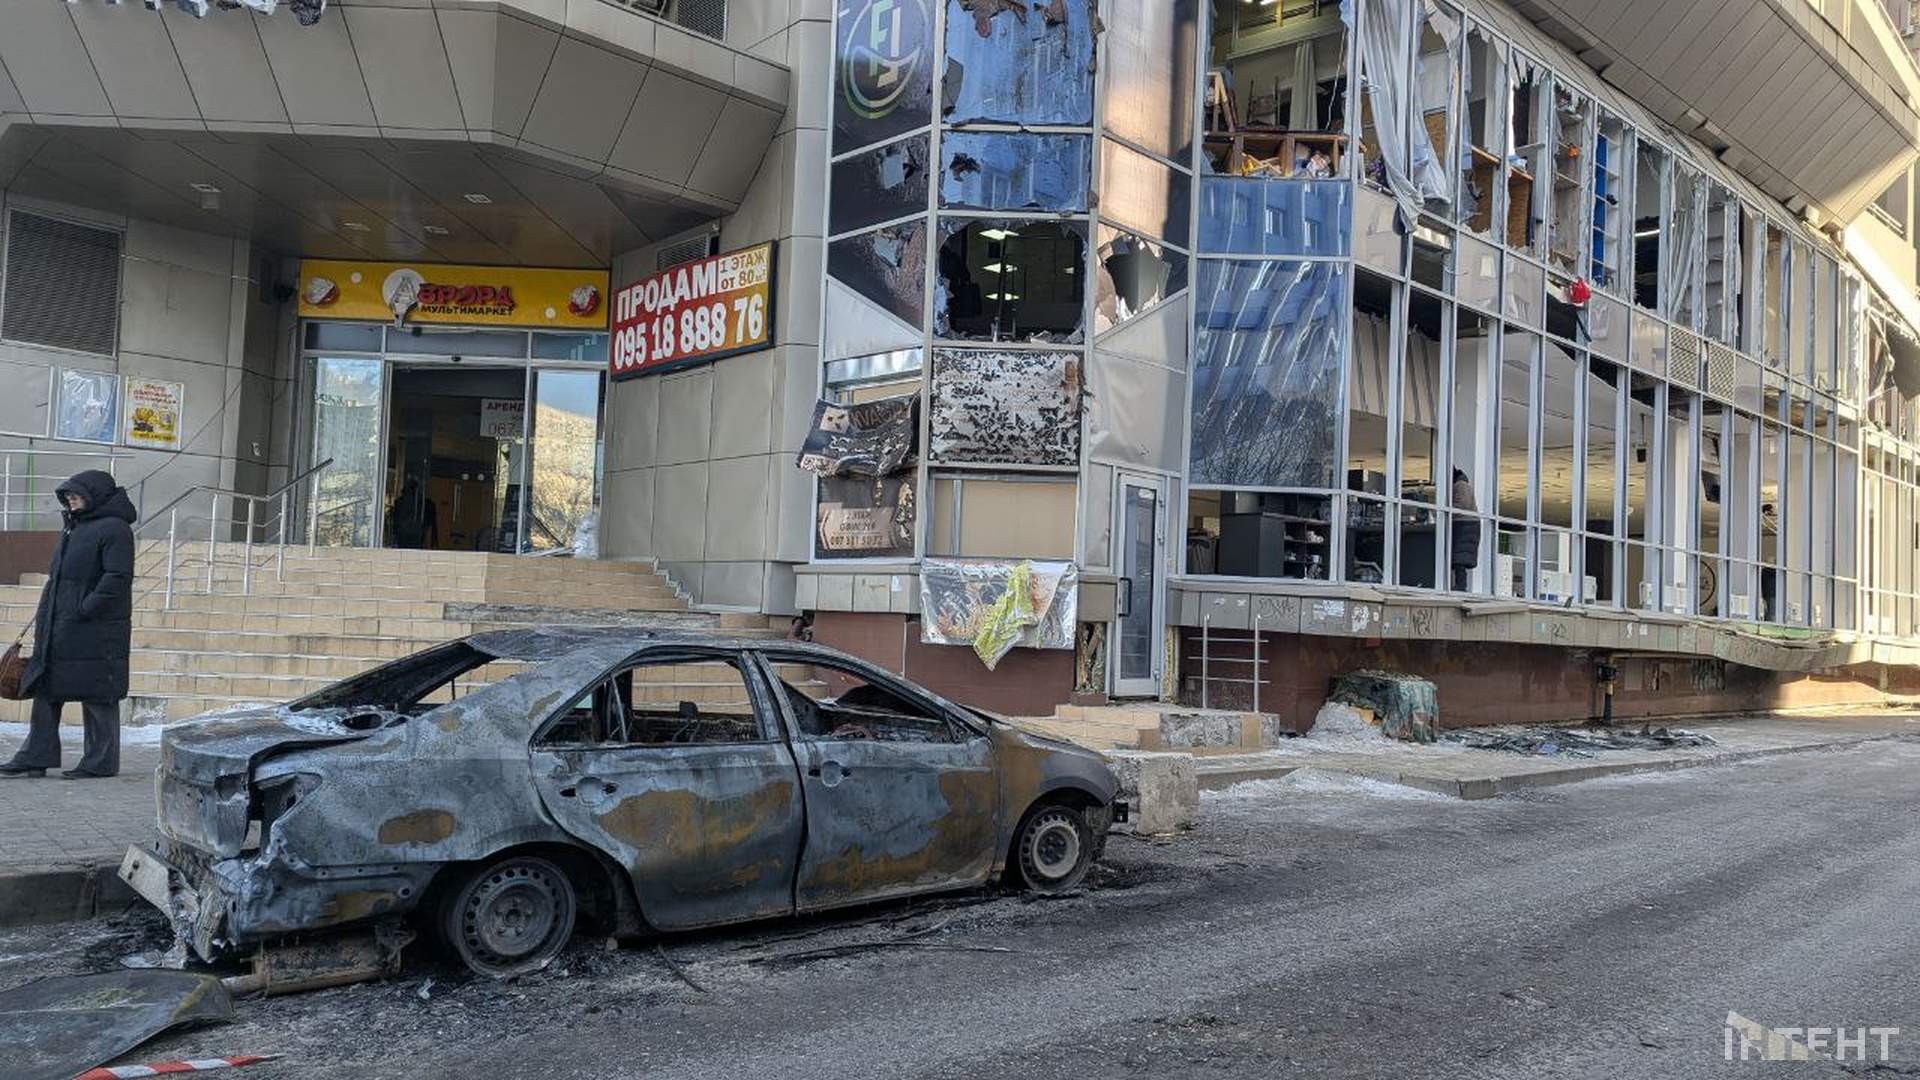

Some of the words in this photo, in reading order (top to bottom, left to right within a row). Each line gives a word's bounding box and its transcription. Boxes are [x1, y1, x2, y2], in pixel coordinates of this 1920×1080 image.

[731, 250, 765, 270] ЭТАЖ
[739, 269, 754, 286] 80
[617, 260, 717, 323] ПРОДАМ
[420, 305, 514, 317] МУЛЬТИМАРКЕТ
[614, 323, 647, 369] 095
[651, 314, 675, 360] 18
[680, 302, 727, 353] 888
[734, 293, 764, 344] 76
[487, 402, 525, 412] АРЕНД
